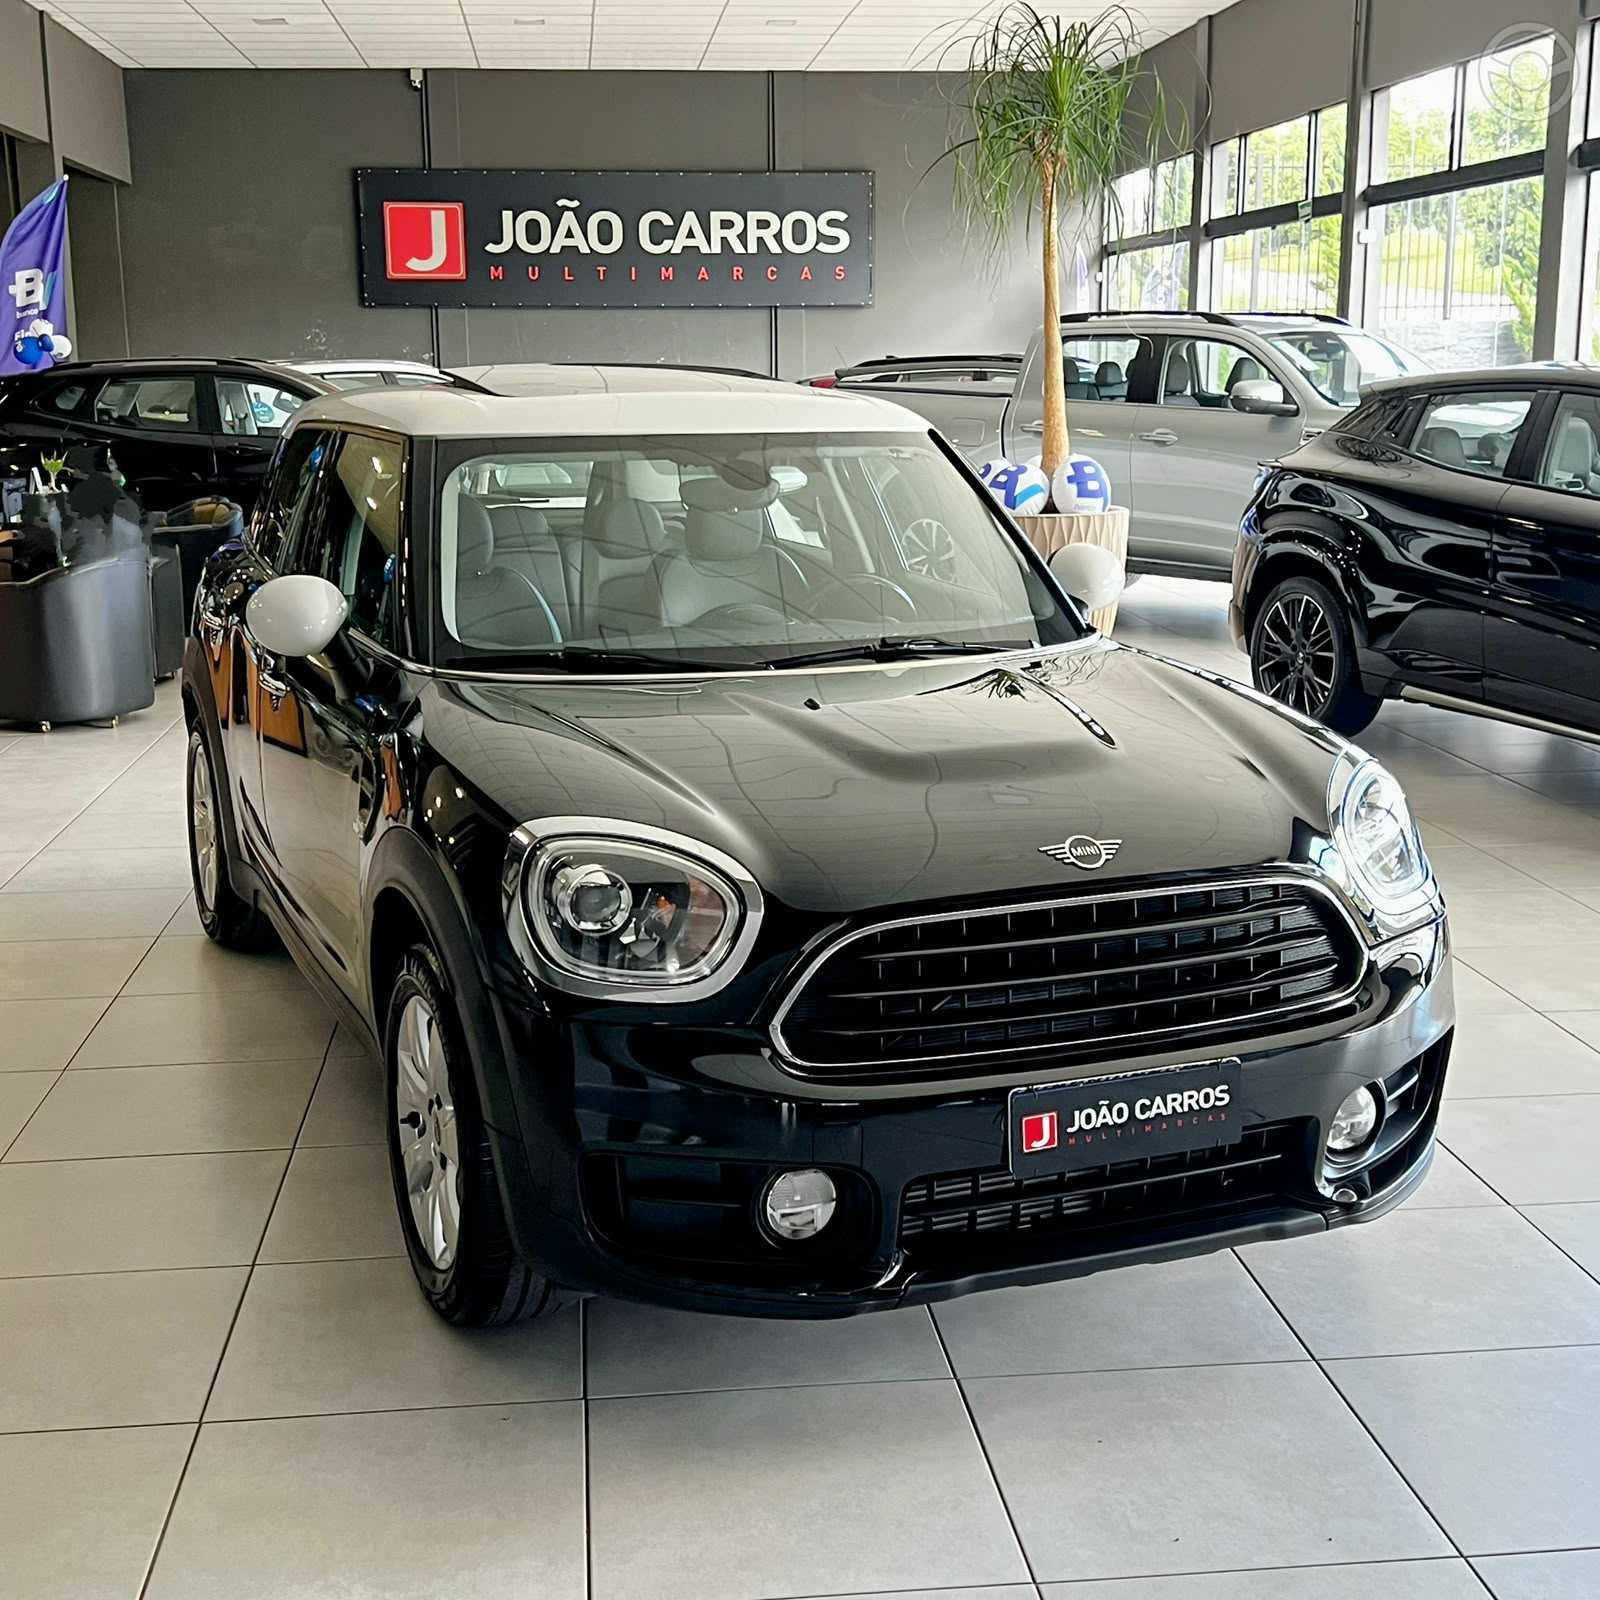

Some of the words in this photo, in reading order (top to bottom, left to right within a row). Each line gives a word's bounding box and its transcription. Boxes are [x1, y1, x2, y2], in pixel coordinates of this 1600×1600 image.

[405, 210, 447, 272] J
[484, 199, 624, 255] JOÃO
[638, 210, 851, 255] CARROS
[489, 265, 847, 282] MULTIMARCAS
[1070, 845, 1100, 857] MINI
[1066, 1100, 1129, 1133] JOÃO
[1134, 1085, 1231, 1120] CARROS
[1030, 1115, 1050, 1148] J
